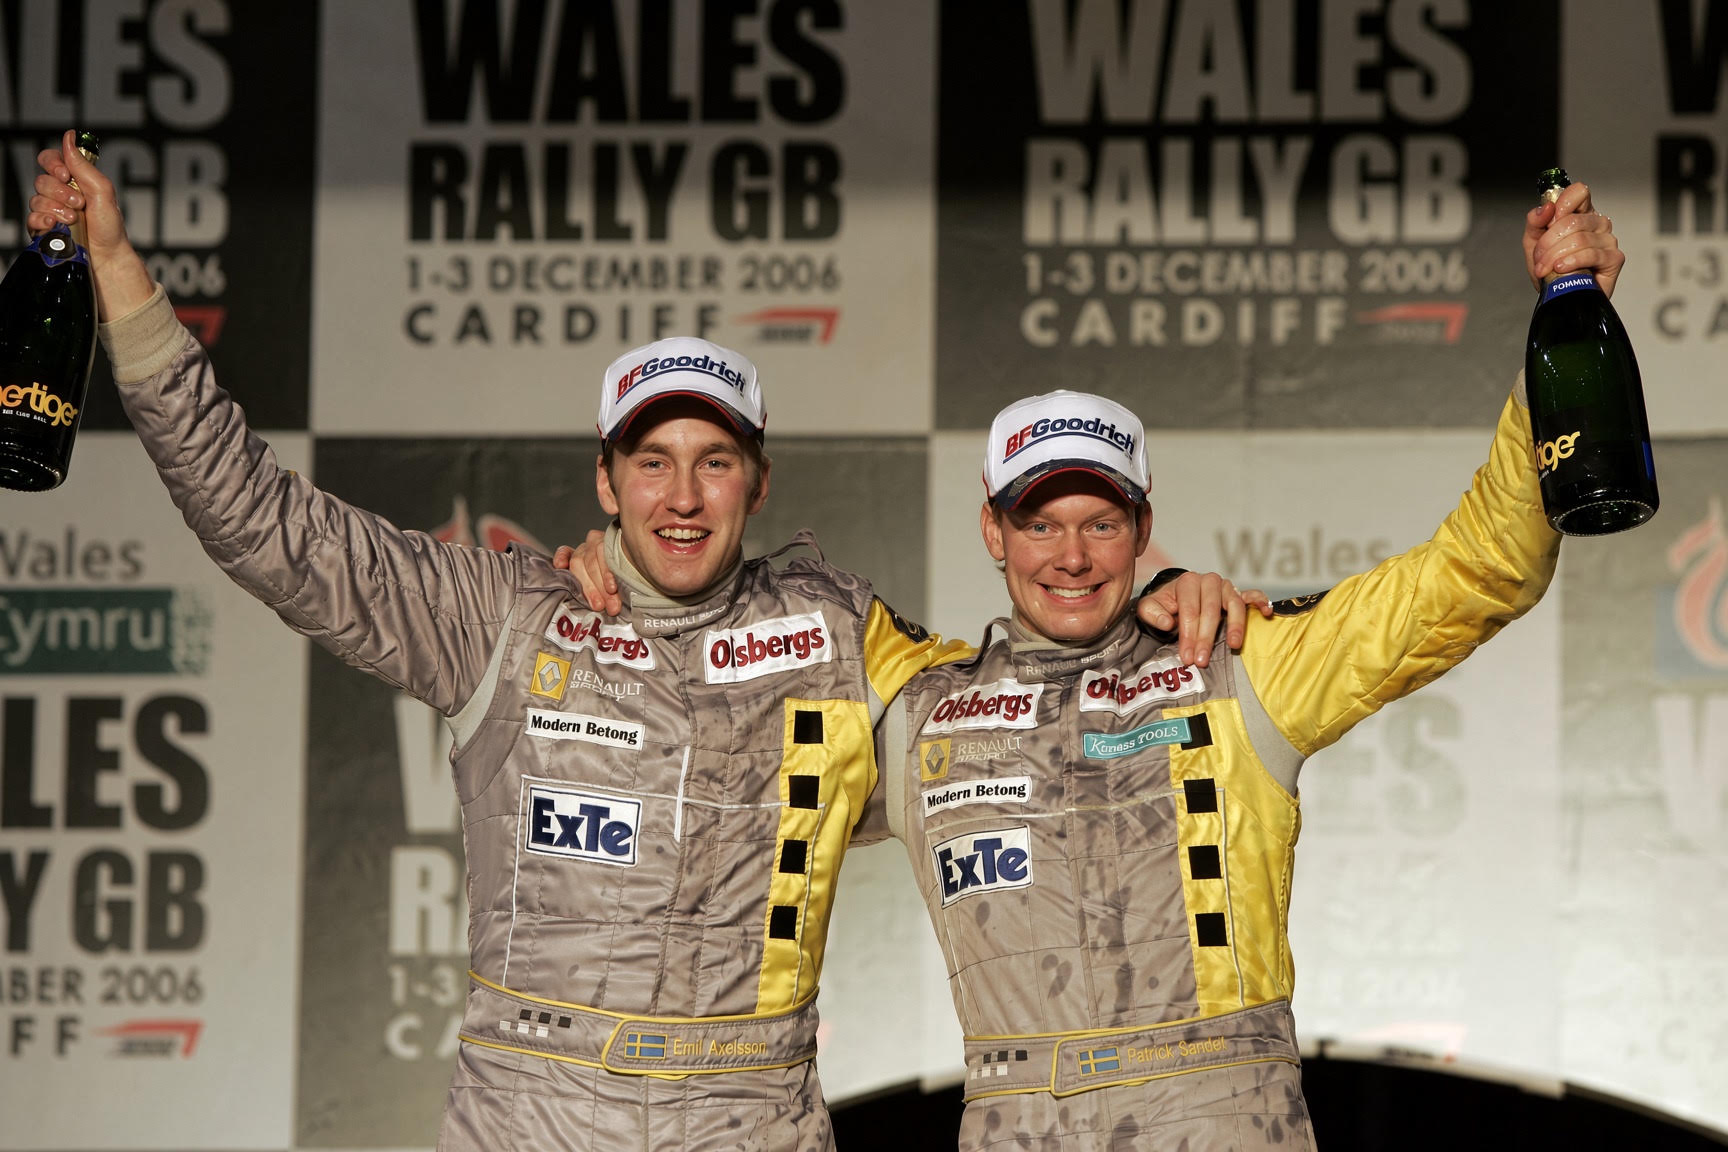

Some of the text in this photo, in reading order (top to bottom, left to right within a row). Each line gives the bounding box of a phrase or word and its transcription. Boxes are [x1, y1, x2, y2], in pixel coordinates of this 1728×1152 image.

[411, 0, 848, 127] WALES
[1029, 0, 1473, 125] WALES
[100, 137, 230, 248] GB
[408, 137, 845, 246] RALLY GB
[1023, 131, 1472, 246] RALLY GB
[146, 253, 226, 298] 006
[406, 254, 842, 294] 1-3 DECEMBER 2006
[1023, 251, 1470, 295] 1-3 DECEMBER 2006
[1655, 251, 1722, 291] 1-3
[405, 303, 724, 347] CARDIFF
[1020, 299, 1348, 347] CARDIFF
[617, 355, 746, 399] BFGoodrich
[0, 382, 78, 426] ertiger
[1005, 417, 1135, 458] BFGoodrich
[1213, 522, 1392, 580] Wales
[0, 599, 165, 666] ymru
[710, 627, 825, 670] Olsbergs
[572, 669, 645, 696] RENAULT
[1025, 659, 1078, 677] RENAUL
[1086, 665, 1194, 705] Olbergs
[531, 714, 638, 744] Modern Betong
[932, 690, 1034, 724] Olsbergs
[958, 736, 1022, 755] RENAULT
[1137, 726, 1179, 745] TOOLS
[927, 783, 1027, 808] Modern Betong
[532, 796, 634, 856] ExTe
[937, 837, 1029, 898] ExTe
[73, 847, 208, 956] GB
[99, 966, 204, 1004] 2006
[673, 1039, 768, 1056] Emil Axelsson
[1127, 1043, 1175, 1065] Patrick
